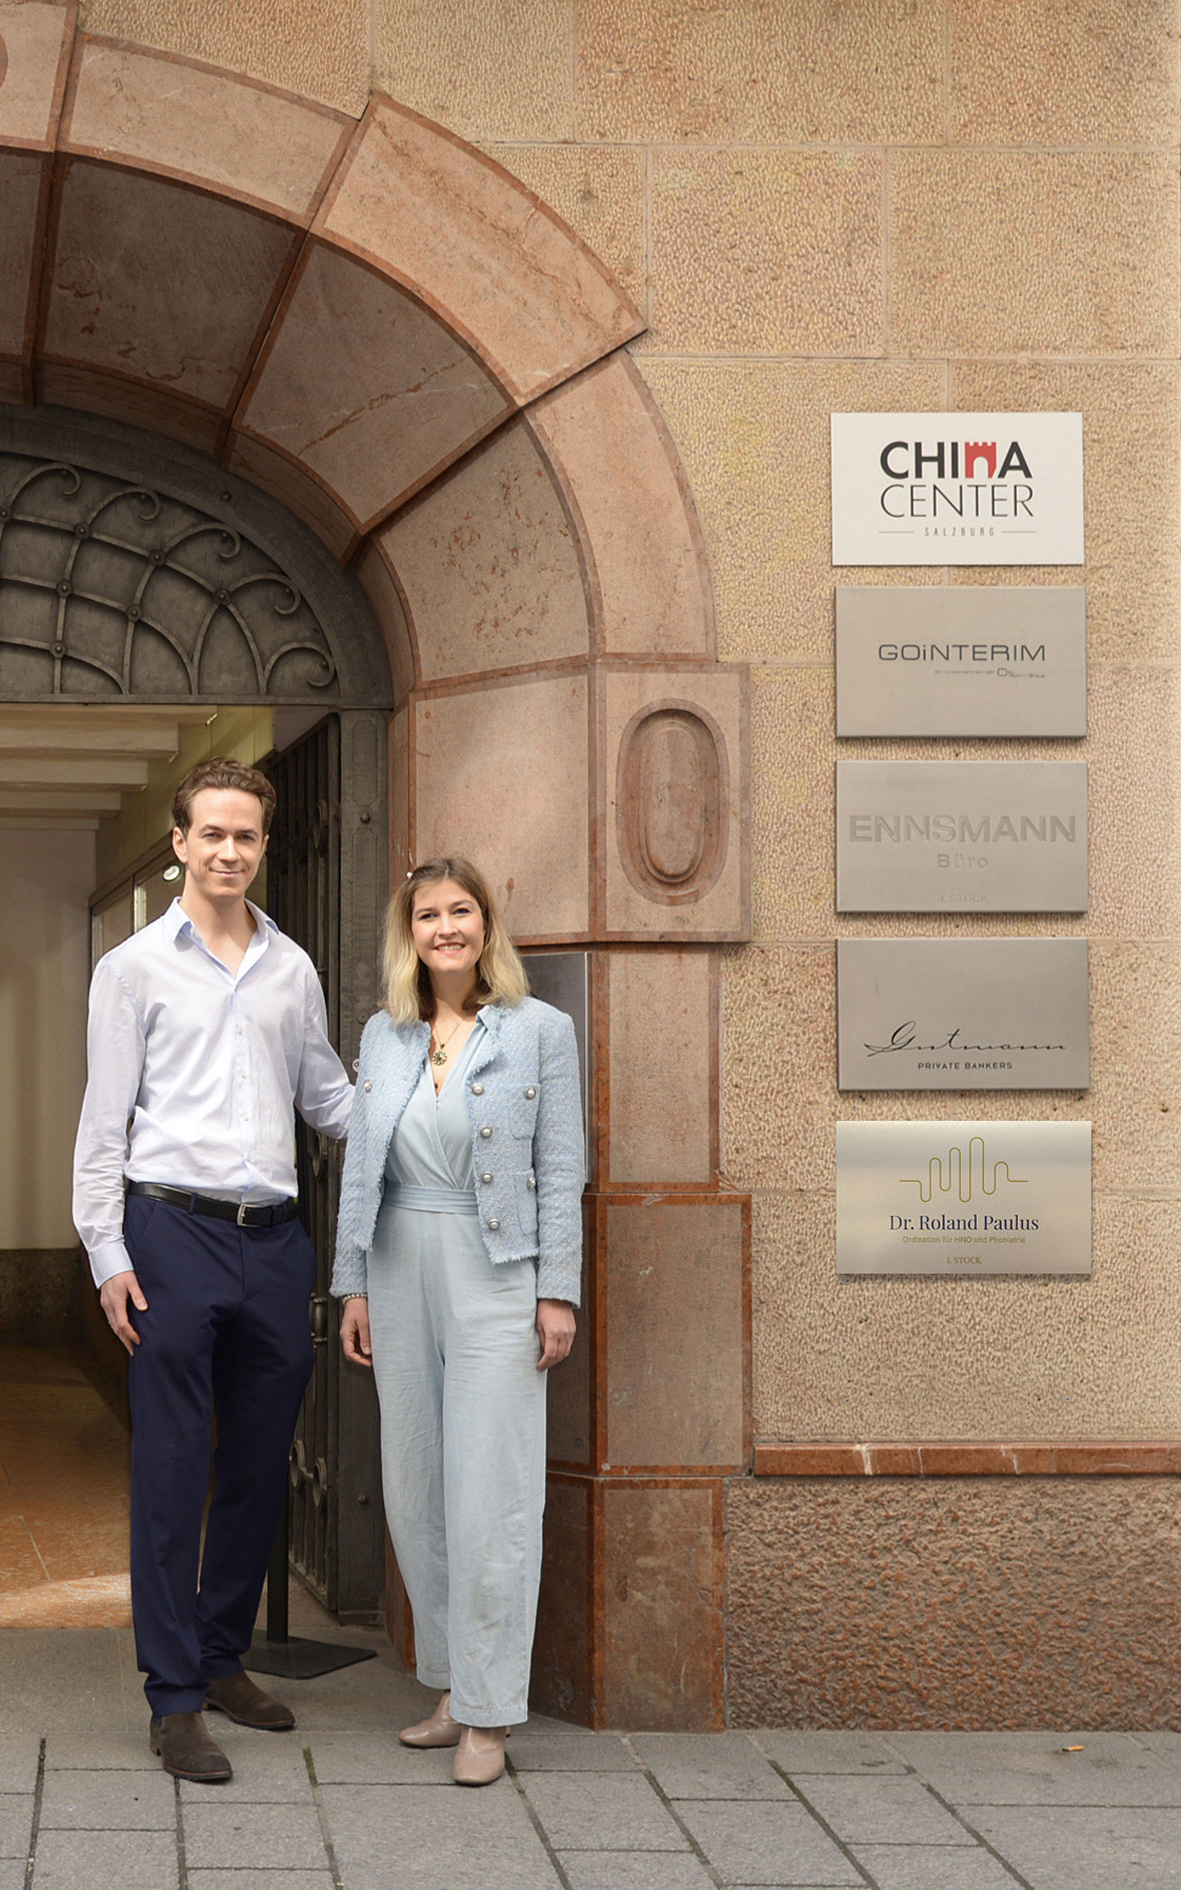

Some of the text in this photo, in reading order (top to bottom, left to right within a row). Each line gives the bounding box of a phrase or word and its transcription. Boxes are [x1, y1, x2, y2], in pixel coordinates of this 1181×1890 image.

[880, 441, 1033, 479] CHINA
[880, 484, 1034, 518] CENTER
[924, 527, 995, 537] SALZBURG
[849, 815, 1076, 843] ENNSMANN
[937, 853, 989, 869] Büro
[864, 1020, 1066, 1058] Gutmann
[918, 1062, 1013, 1070] PRIVATE BANKERS
[889, 1214, 1039, 1231] Dr. Roland Paulus
[903, 1235, 1026, 1244] Ordination für HNO und Phoniatrie
[953, 1256, 982, 1265] STOCK
